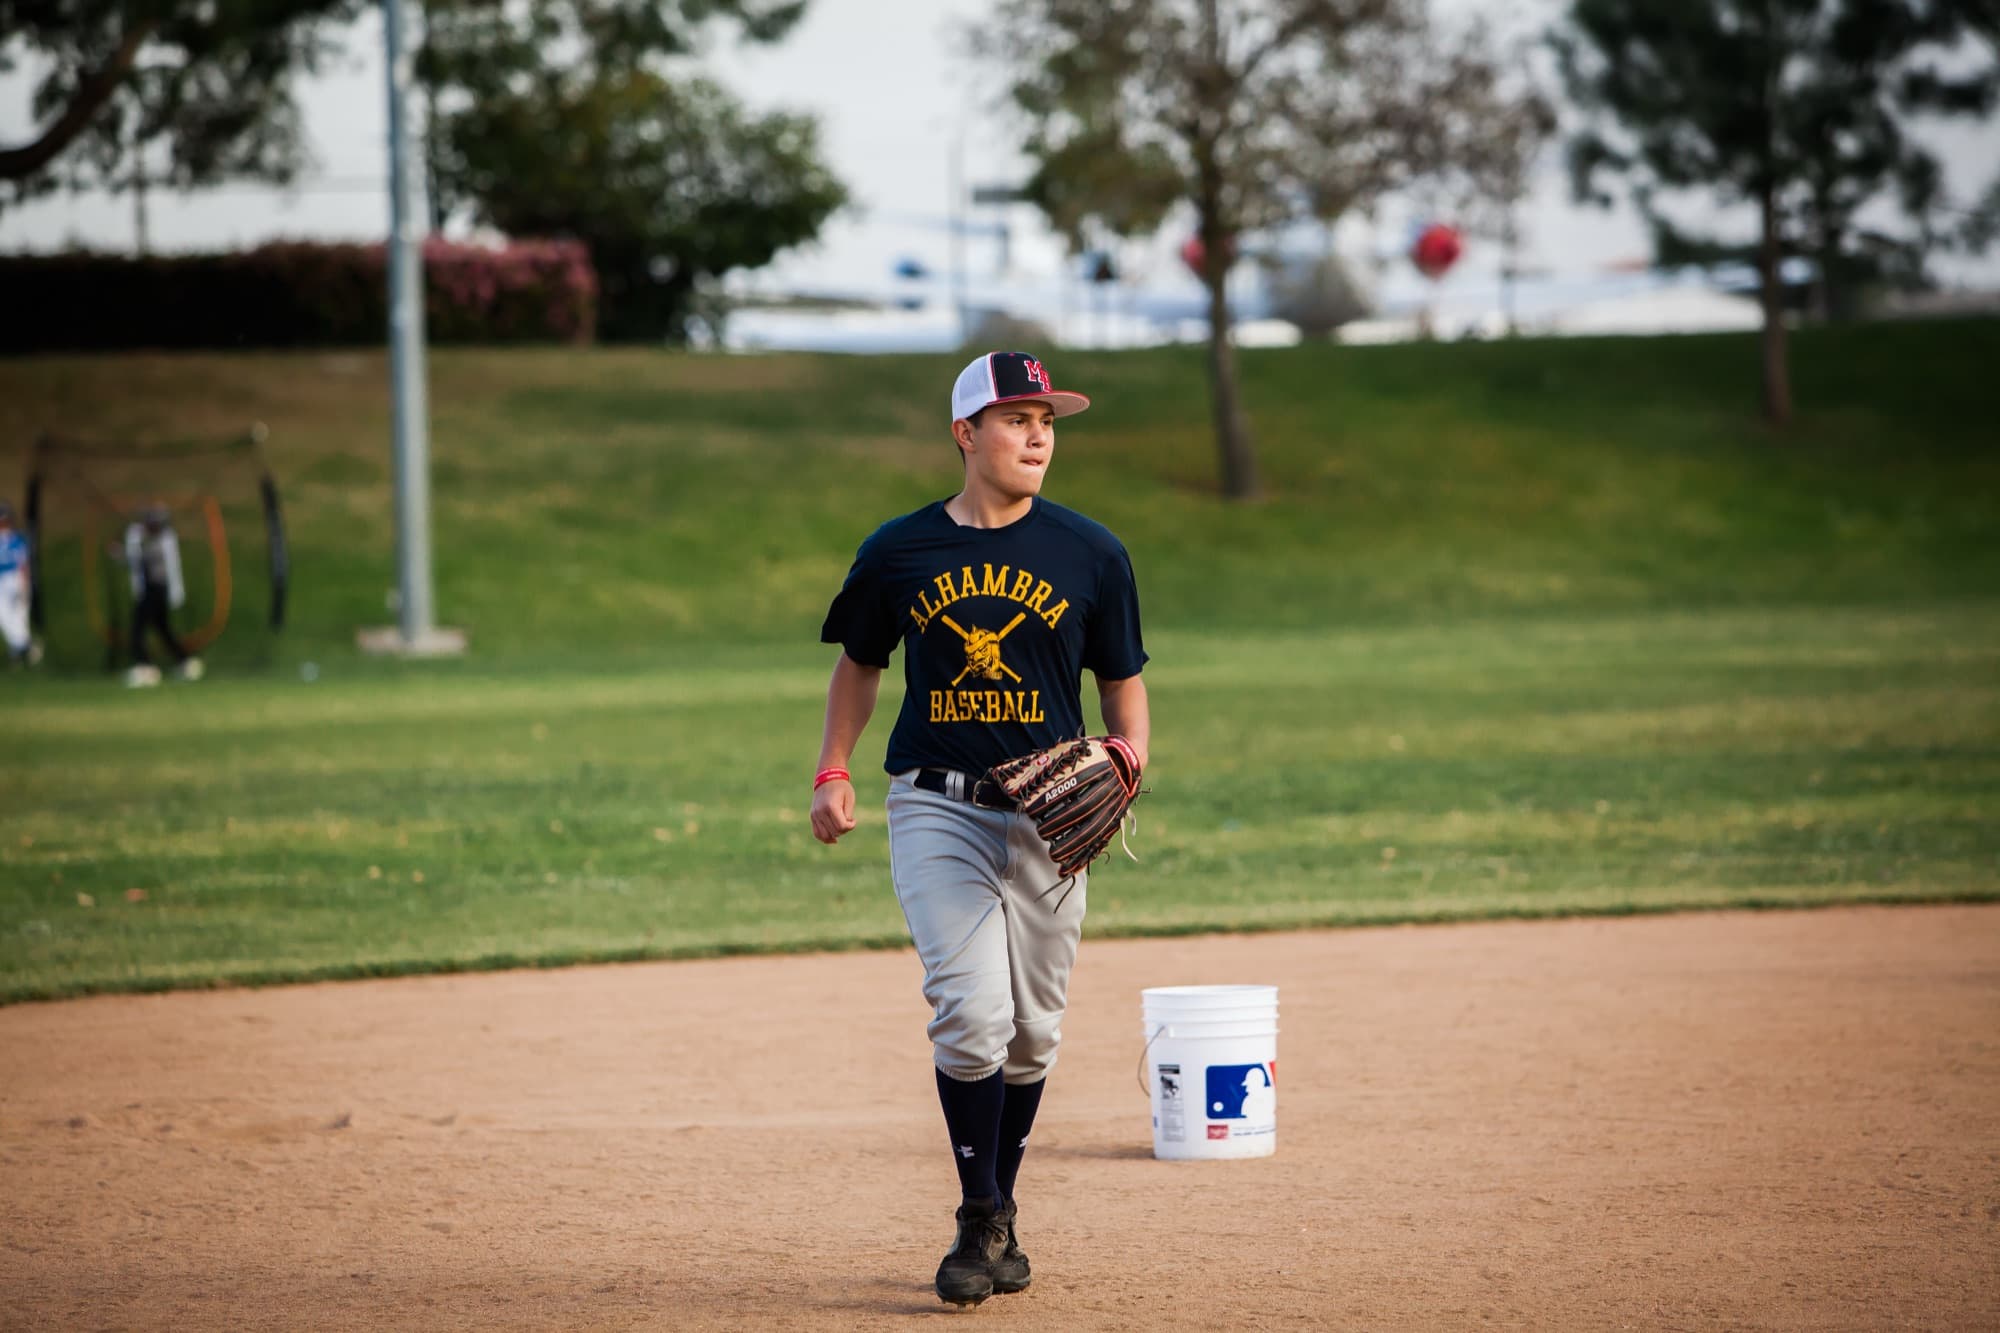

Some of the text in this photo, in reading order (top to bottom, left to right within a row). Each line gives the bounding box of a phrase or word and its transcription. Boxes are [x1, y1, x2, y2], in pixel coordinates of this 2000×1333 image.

[910, 563, 1070, 634] ALHAMBRA
[929, 690, 1044, 723] BASEBALL
[1045, 777, 1077, 803] A2000
